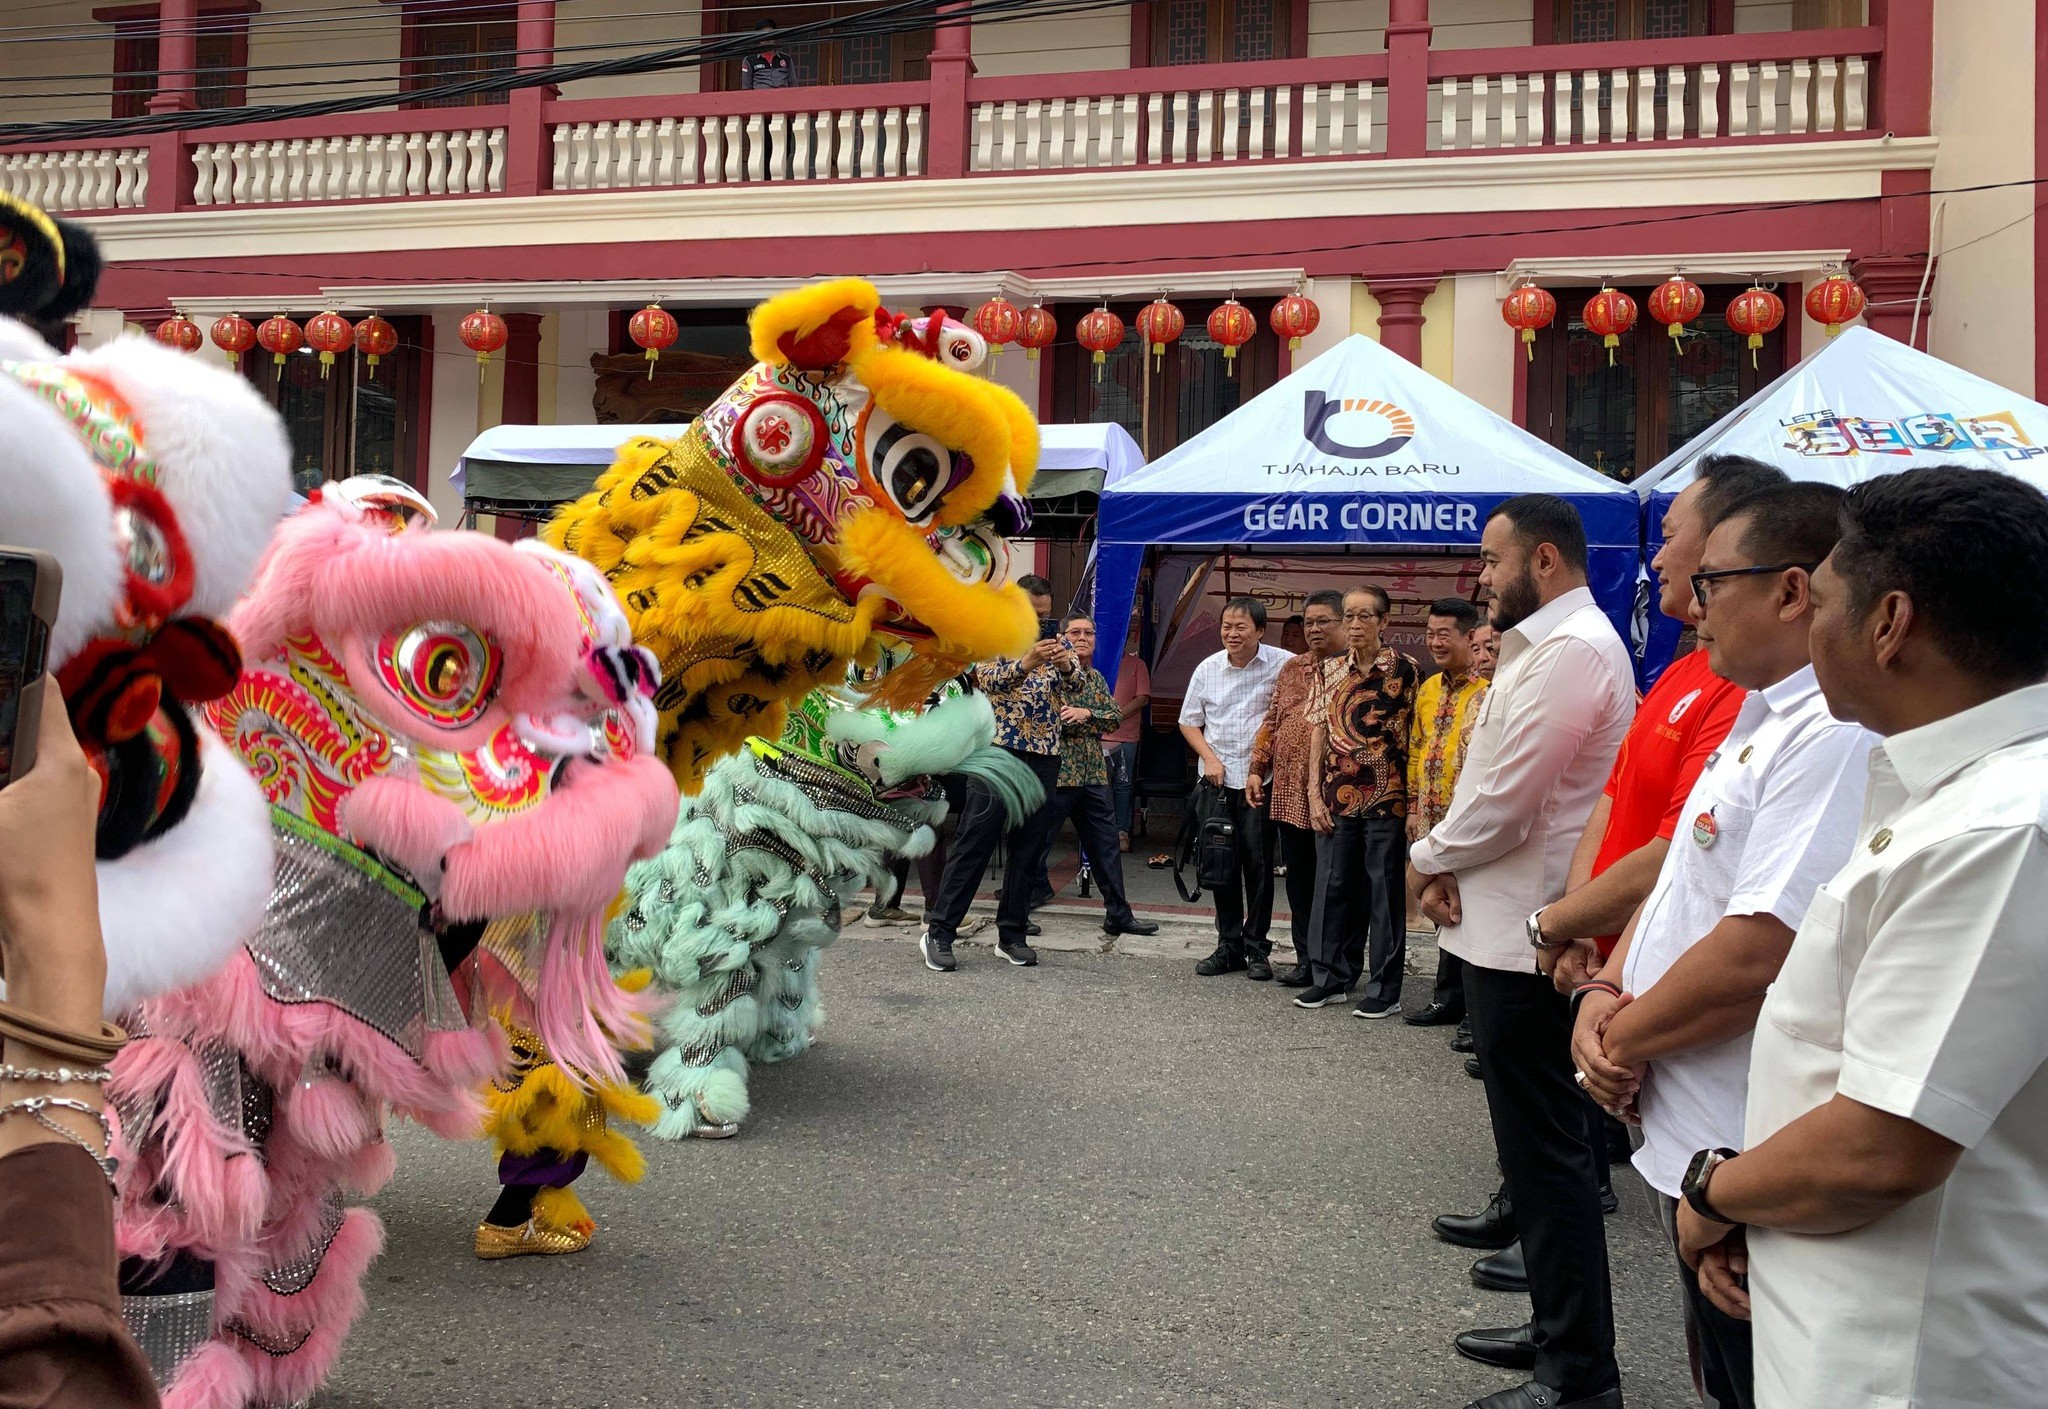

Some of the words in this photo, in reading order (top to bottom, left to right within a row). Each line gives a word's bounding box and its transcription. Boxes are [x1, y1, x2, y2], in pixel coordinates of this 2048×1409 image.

[1779, 409, 1835, 427] LET'S
[1792, 413, 2026, 457] GEAR
[1261, 462, 1378, 476] TJAHAJA
[1385, 463, 1461, 476] BARU
[1243, 503, 1329, 531] GEAR
[1340, 503, 1478, 531] CORNER
